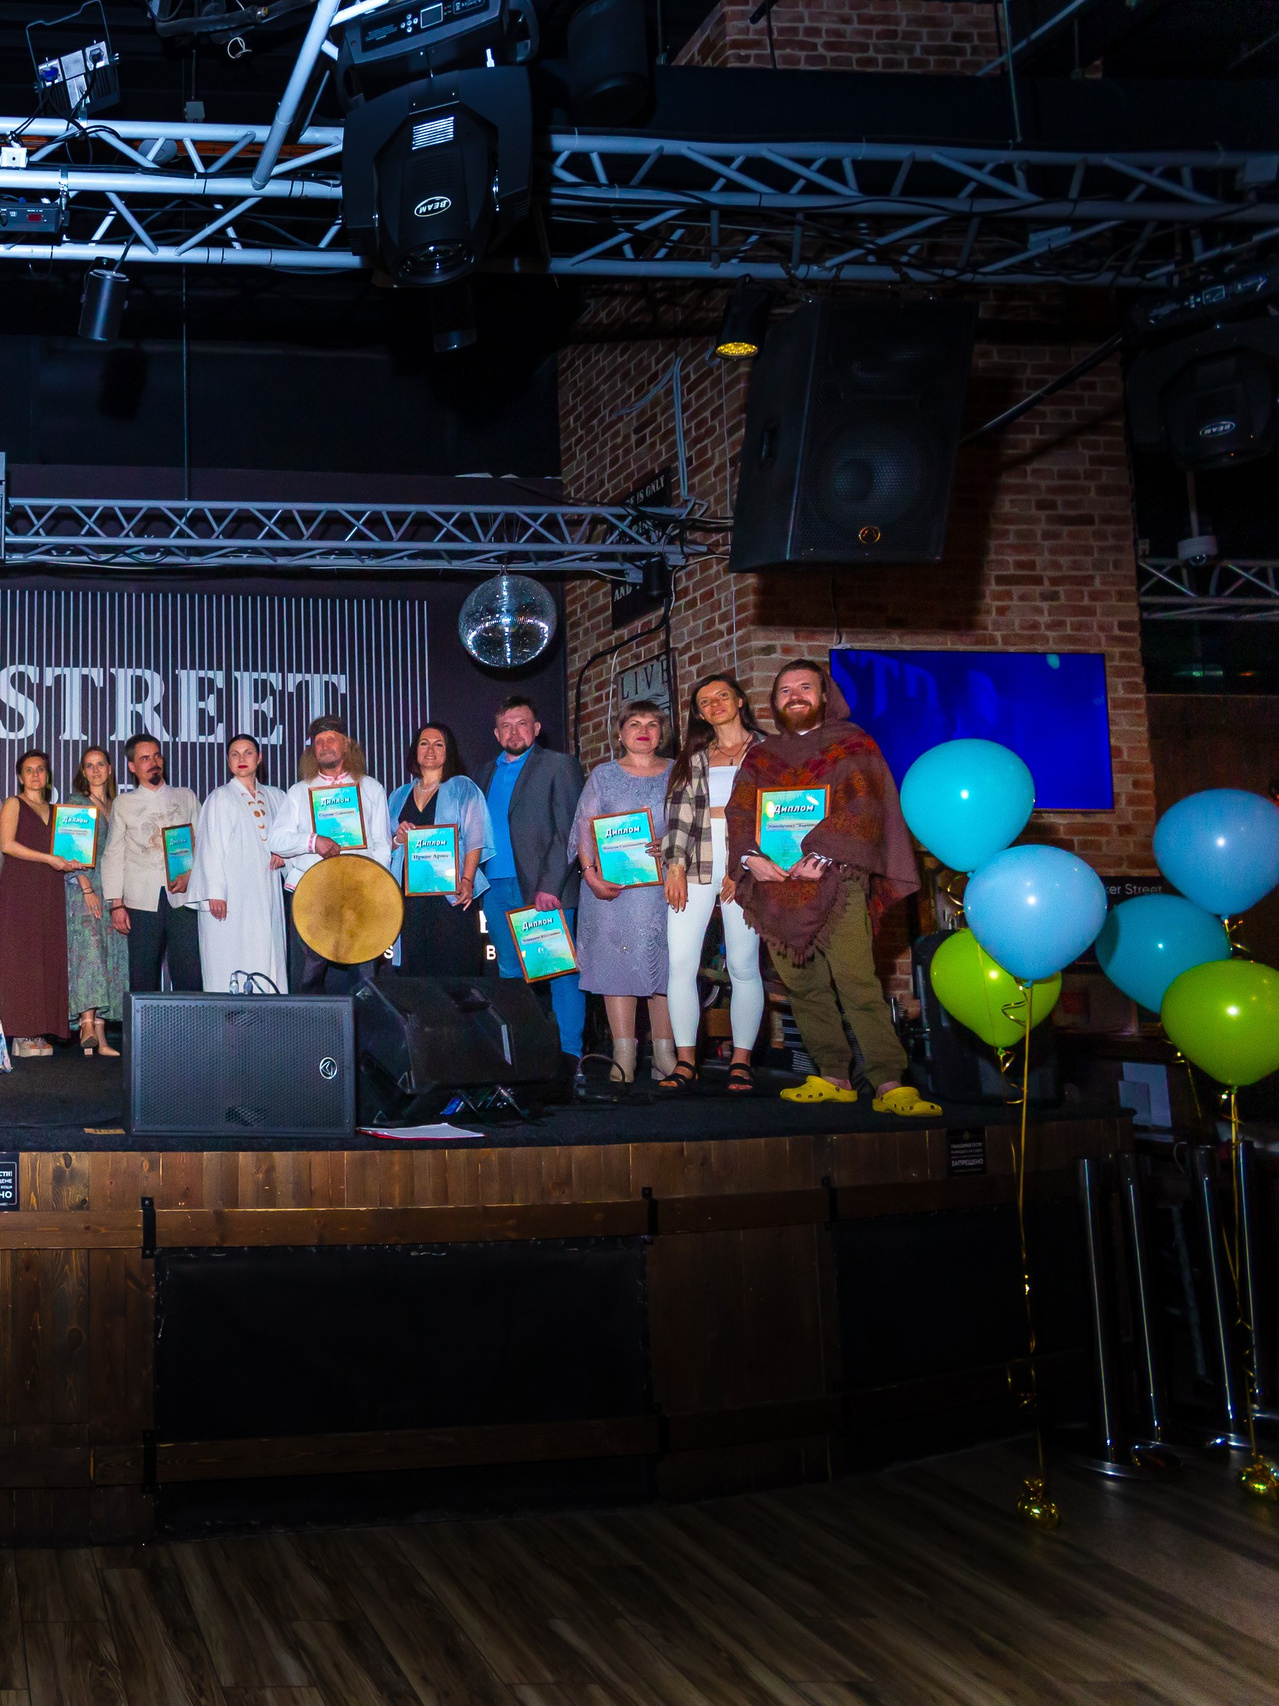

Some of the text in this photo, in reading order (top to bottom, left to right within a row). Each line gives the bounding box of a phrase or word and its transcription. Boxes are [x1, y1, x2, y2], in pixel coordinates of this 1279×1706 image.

[419, 199, 449, 214] BEAM
[645, 474, 665, 497] ONLY
[321, 797, 351, 806] Диплом
[773, 804, 815, 815] Диплом
[63, 816, 89, 824] Диплом
[605, 826, 641, 839] Диплом
[416, 840, 447, 849] Диплом
[1124, 883, 1162, 895] Street
[522, 917, 554, 931] Диплом
